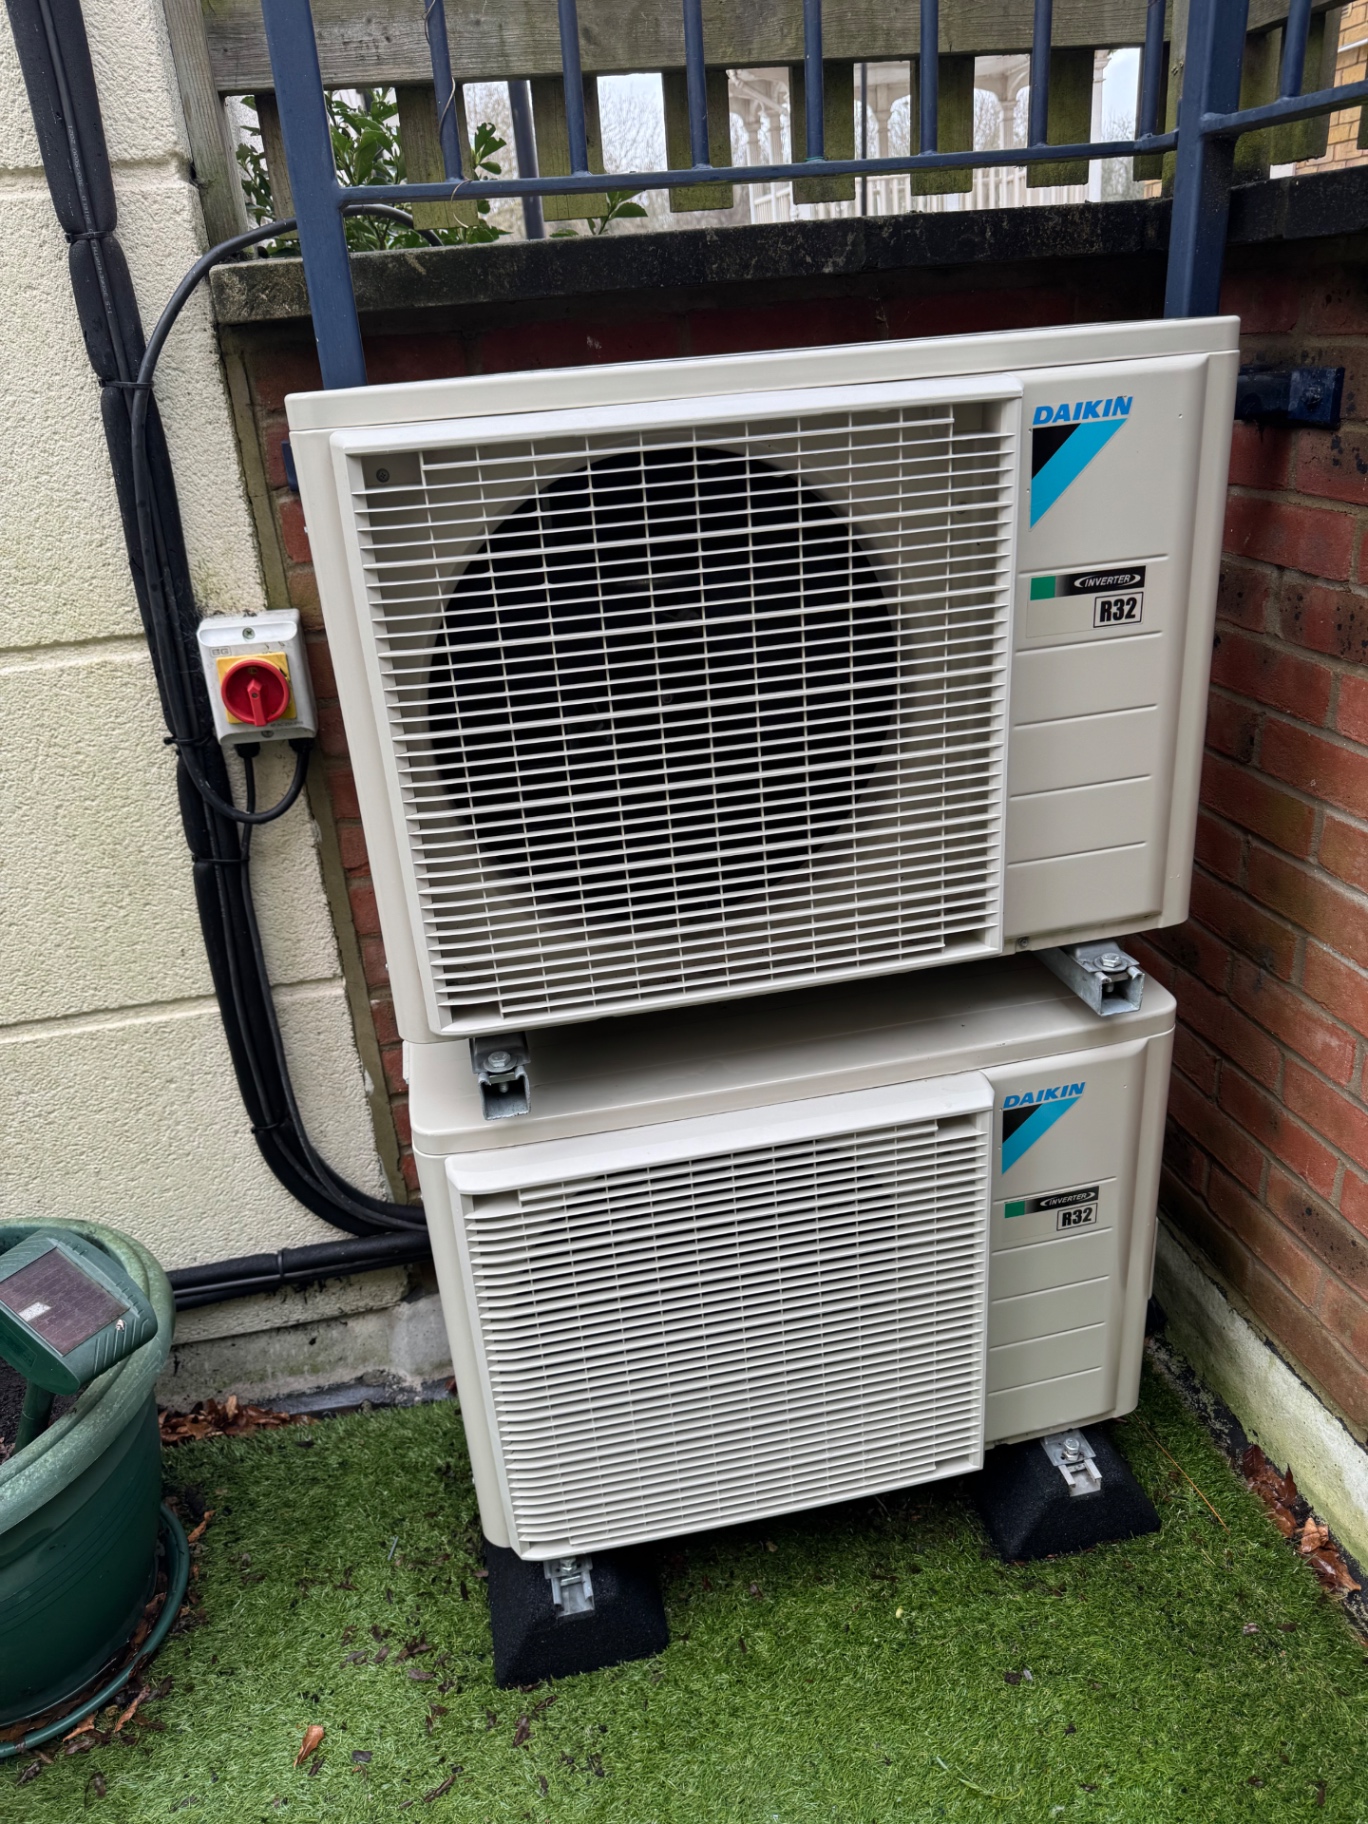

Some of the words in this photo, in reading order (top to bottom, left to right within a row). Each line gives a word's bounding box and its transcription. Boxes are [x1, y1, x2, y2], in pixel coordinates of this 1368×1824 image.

[1032, 396, 1133, 425] DAIKIN
[1084, 574, 1131, 587] INVERTER
[1099, 597, 1137, 622] R32
[1003, 1082, 1086, 1108] DAIKIN
[1048, 1192, 1087, 1206] INVERTER
[1061, 1207, 1093, 1227] R32
